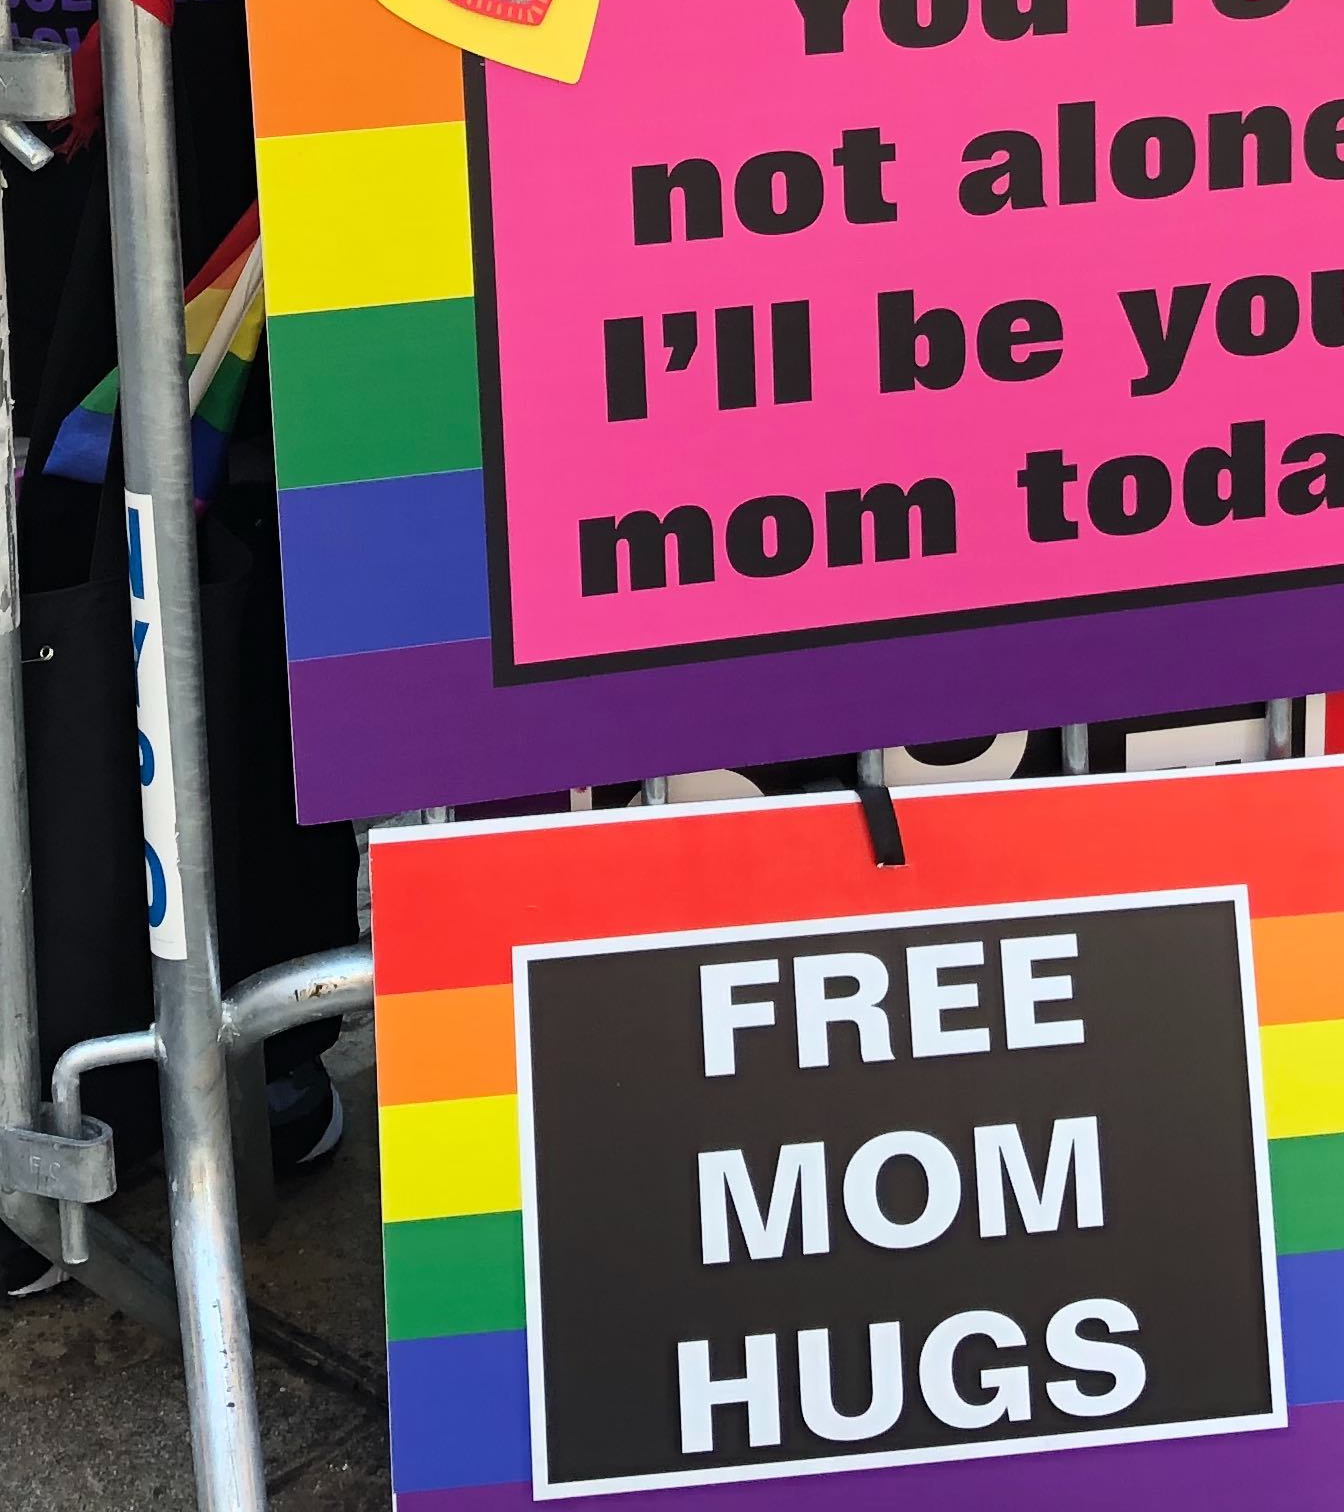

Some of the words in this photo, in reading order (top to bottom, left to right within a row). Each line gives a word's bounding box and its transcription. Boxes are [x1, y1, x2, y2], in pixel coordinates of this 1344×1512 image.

[632, 126, 898, 246] not
[603, 299, 813, 423] I'll
[878, 289, 1064, 394] be
[578, 477, 958, 598] mom
[699, 933, 1085, 1077] FREE
[697, 1115, 1104, 1265] MOM
[677, 1298, 1147, 1454] HUGS
